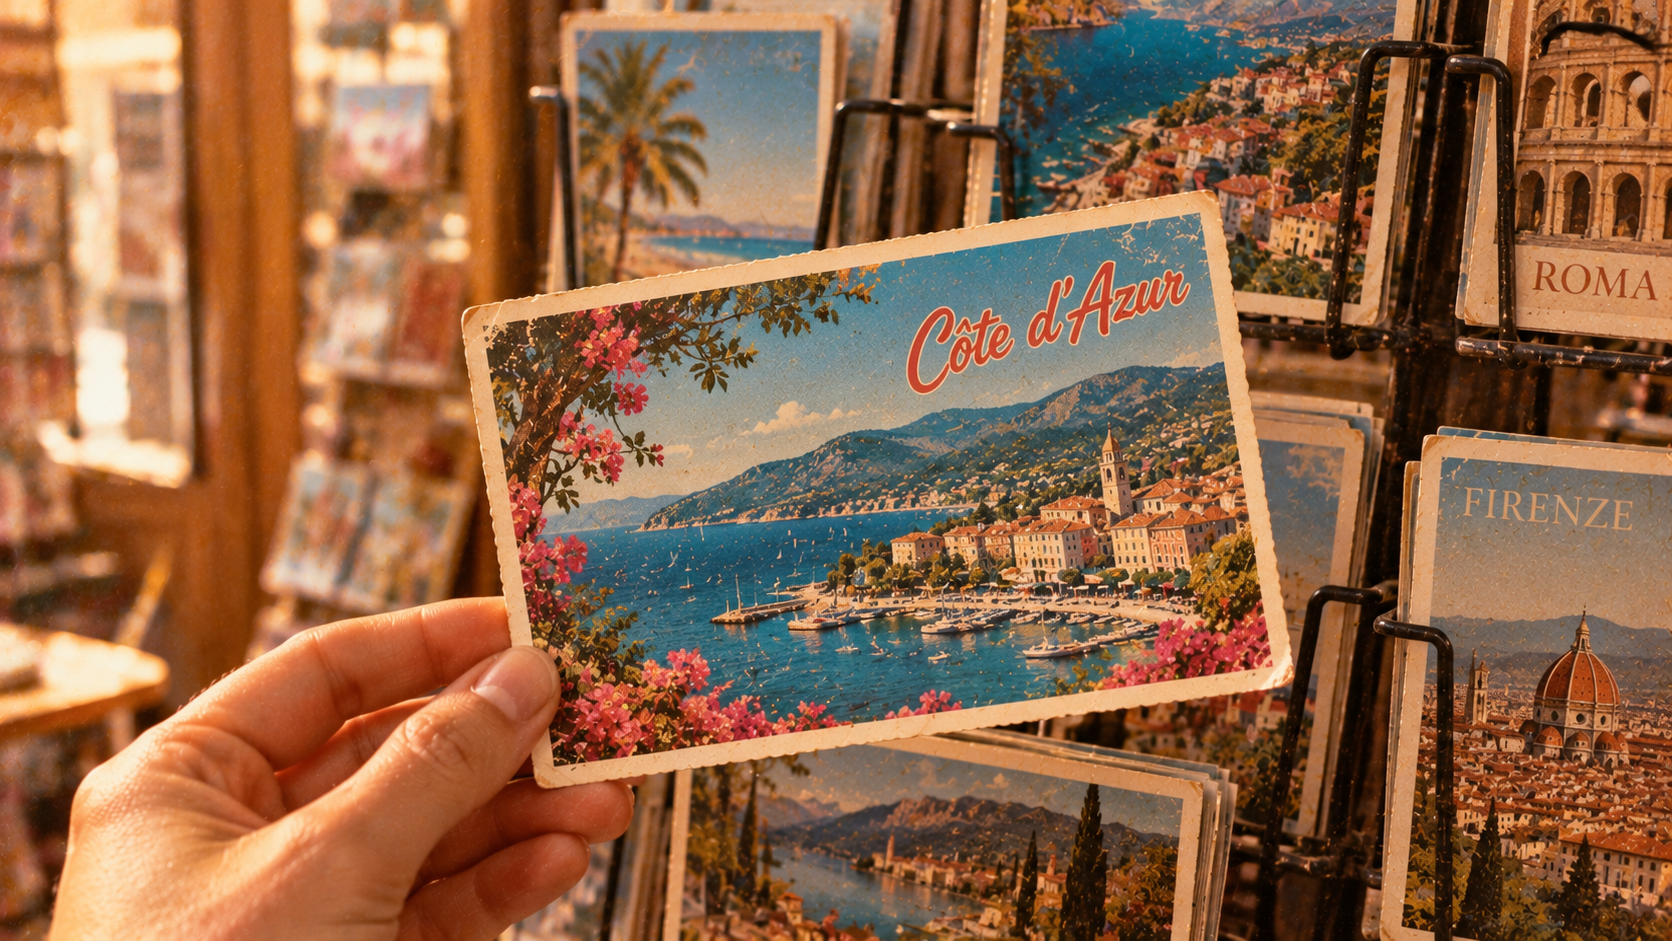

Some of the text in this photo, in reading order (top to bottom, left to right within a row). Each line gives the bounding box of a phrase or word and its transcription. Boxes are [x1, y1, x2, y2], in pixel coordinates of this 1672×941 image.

[1532, 260, 1658, 301] ROMA
[906, 260, 1191, 394] Côte d'Azur
[1462, 486, 1634, 531] FIRENZE
